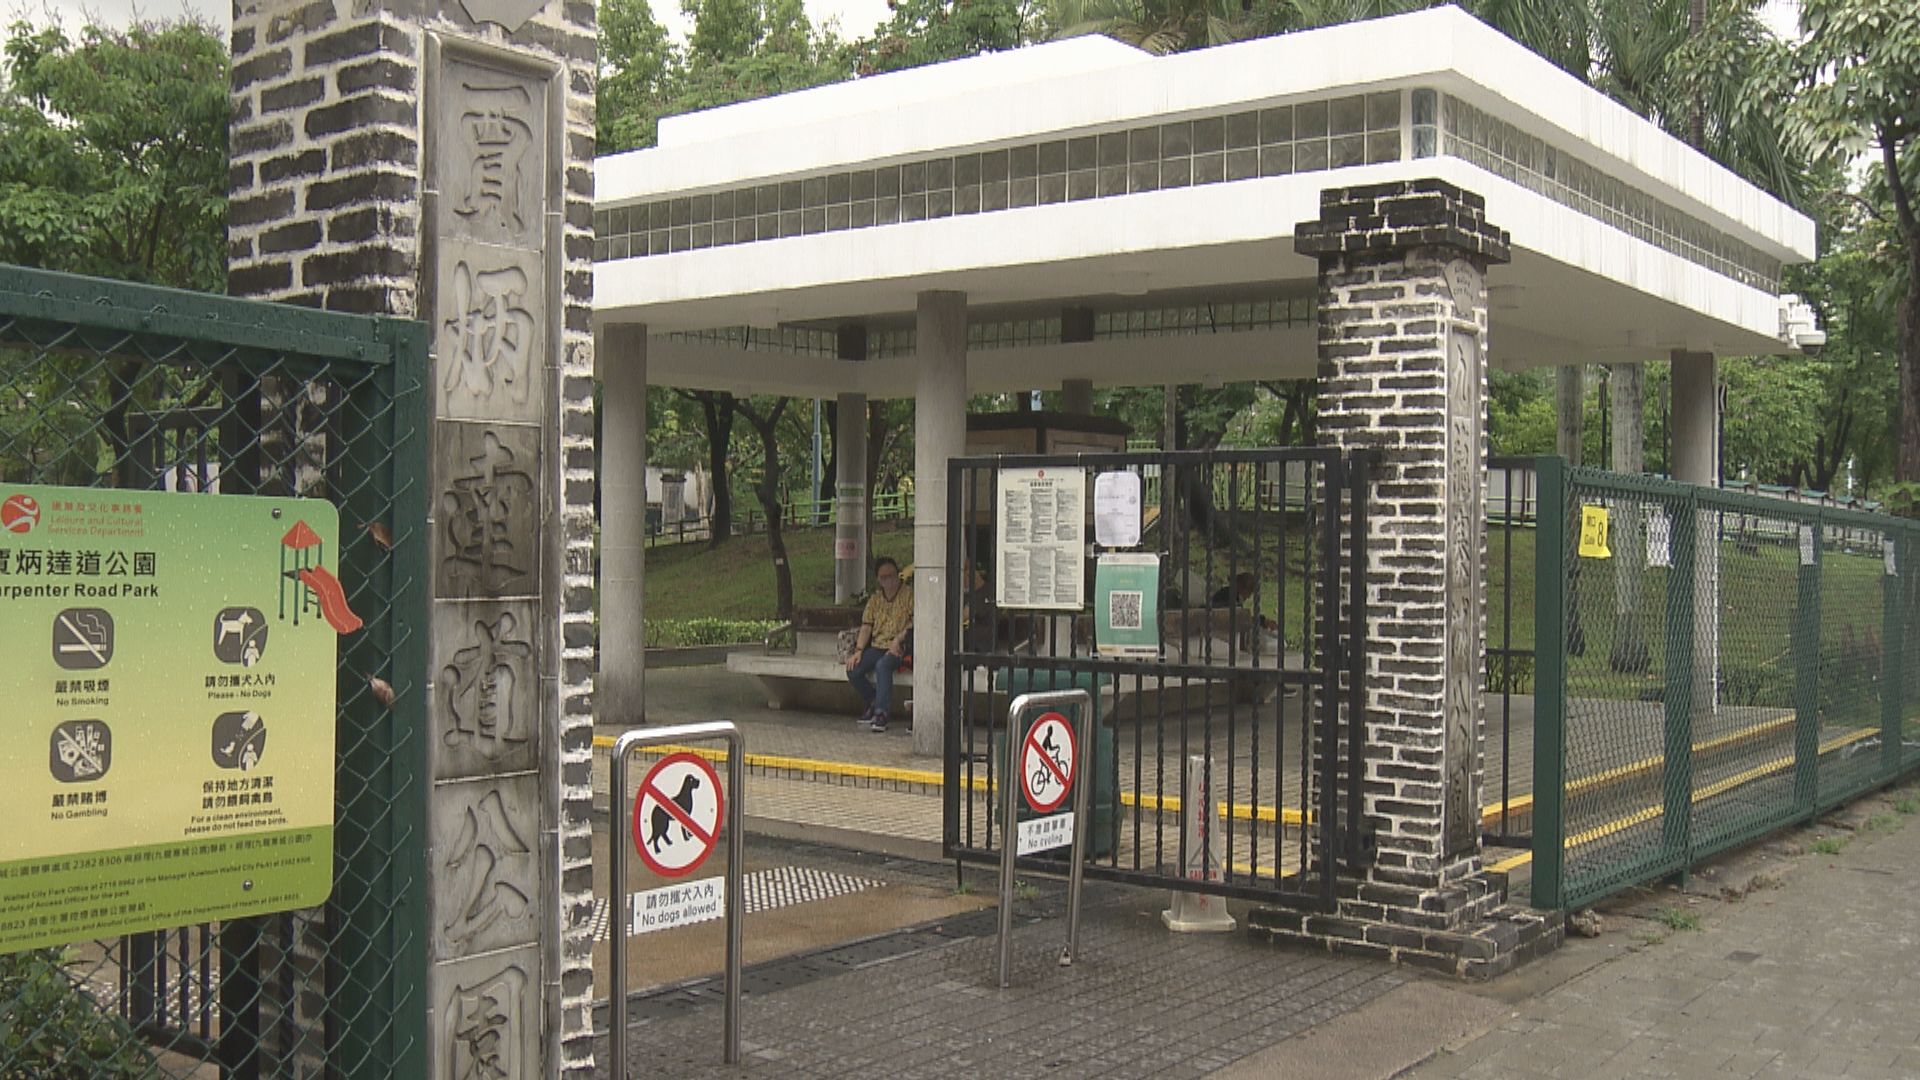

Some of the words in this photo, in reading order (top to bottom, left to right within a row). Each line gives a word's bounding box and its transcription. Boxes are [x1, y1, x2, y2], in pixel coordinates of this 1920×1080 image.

[90, 527, 144, 538] Department
[0, 584, 70, 599] rpenter
[74, 583, 118, 597] Road
[122, 583, 159, 597] Park
[55, 680, 109, 693] 嚴禁吸煙
[205, 672, 276, 687] 請勿攜犬入內
[208, 691, 234, 699] Please
[252, 689, 272, 698] Dogs
[57, 698, 69, 707] No
[71, 697, 109, 706] Smoking
[203, 776, 273, 793] 保持地方清潔
[52, 790, 107, 807] 嚴禁賭博
[51, 811, 64, 820] No
[66, 808, 108, 818] Gambling
[191, 815, 205, 823] For
[213, 812, 234, 821] clean
[184, 825, 211, 835] please
[212, 823, 222, 831] do
[237, 820, 254, 828] feed
[254, 818, 267, 826] the
[1028, 838, 1038, 849] No
[646, 883, 714, 909] 請勿攜犬入內
[642, 913, 656, 927] No
[658, 910, 680, 923] dogs
[683, 901, 716, 918] allowed
